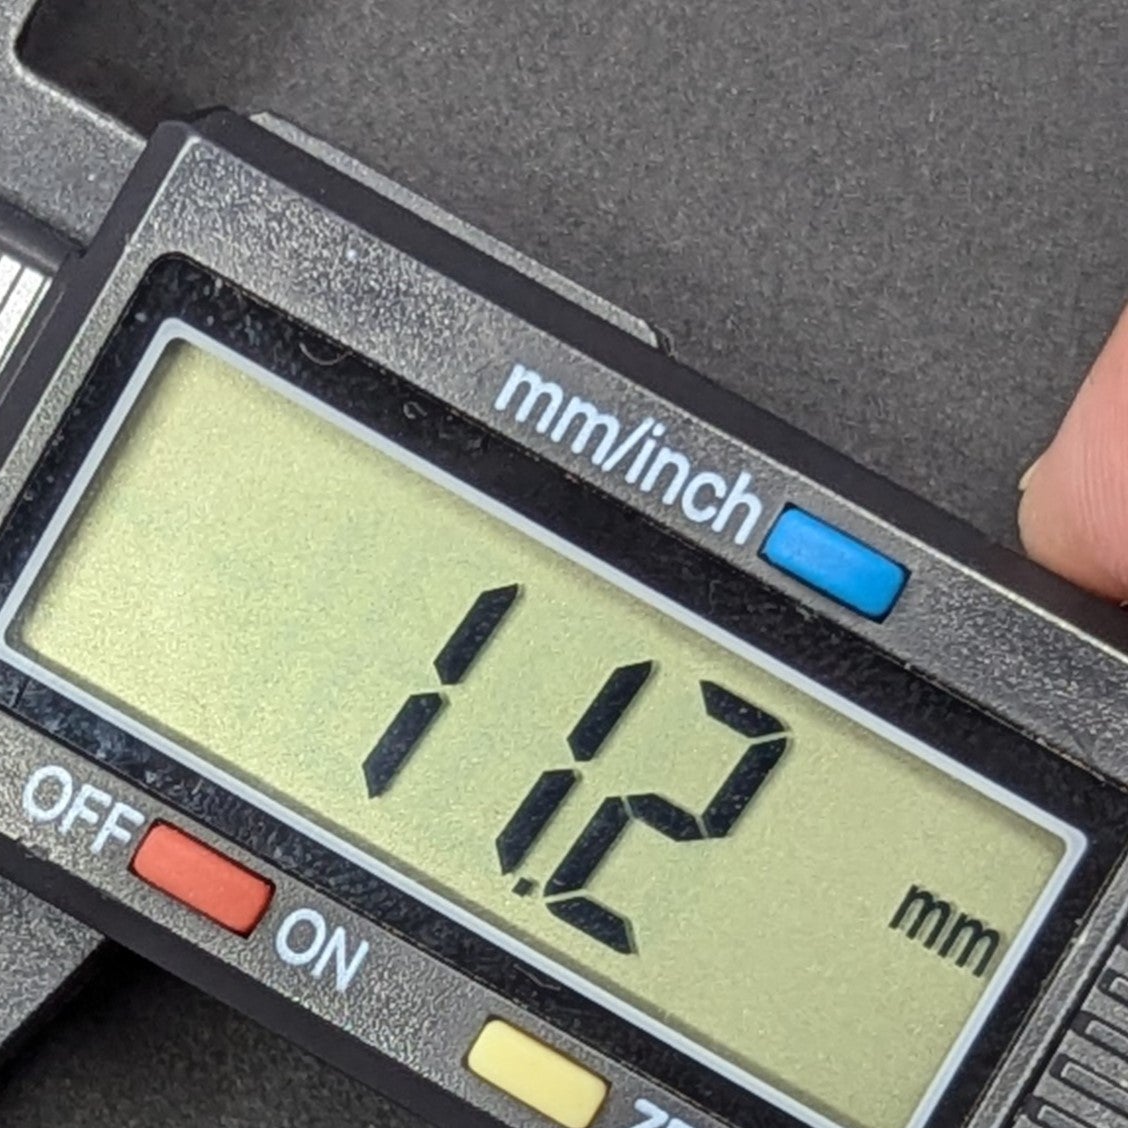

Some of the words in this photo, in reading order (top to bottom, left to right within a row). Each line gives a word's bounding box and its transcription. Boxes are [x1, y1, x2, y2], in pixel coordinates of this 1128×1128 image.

[494, 363, 763, 546] mm/inch
[21, 765, 146, 855] OFF
[275, 907, 371, 993] ON
[362, 583, 790, 956] 11.2
[888, 884, 1001, 979] mm
